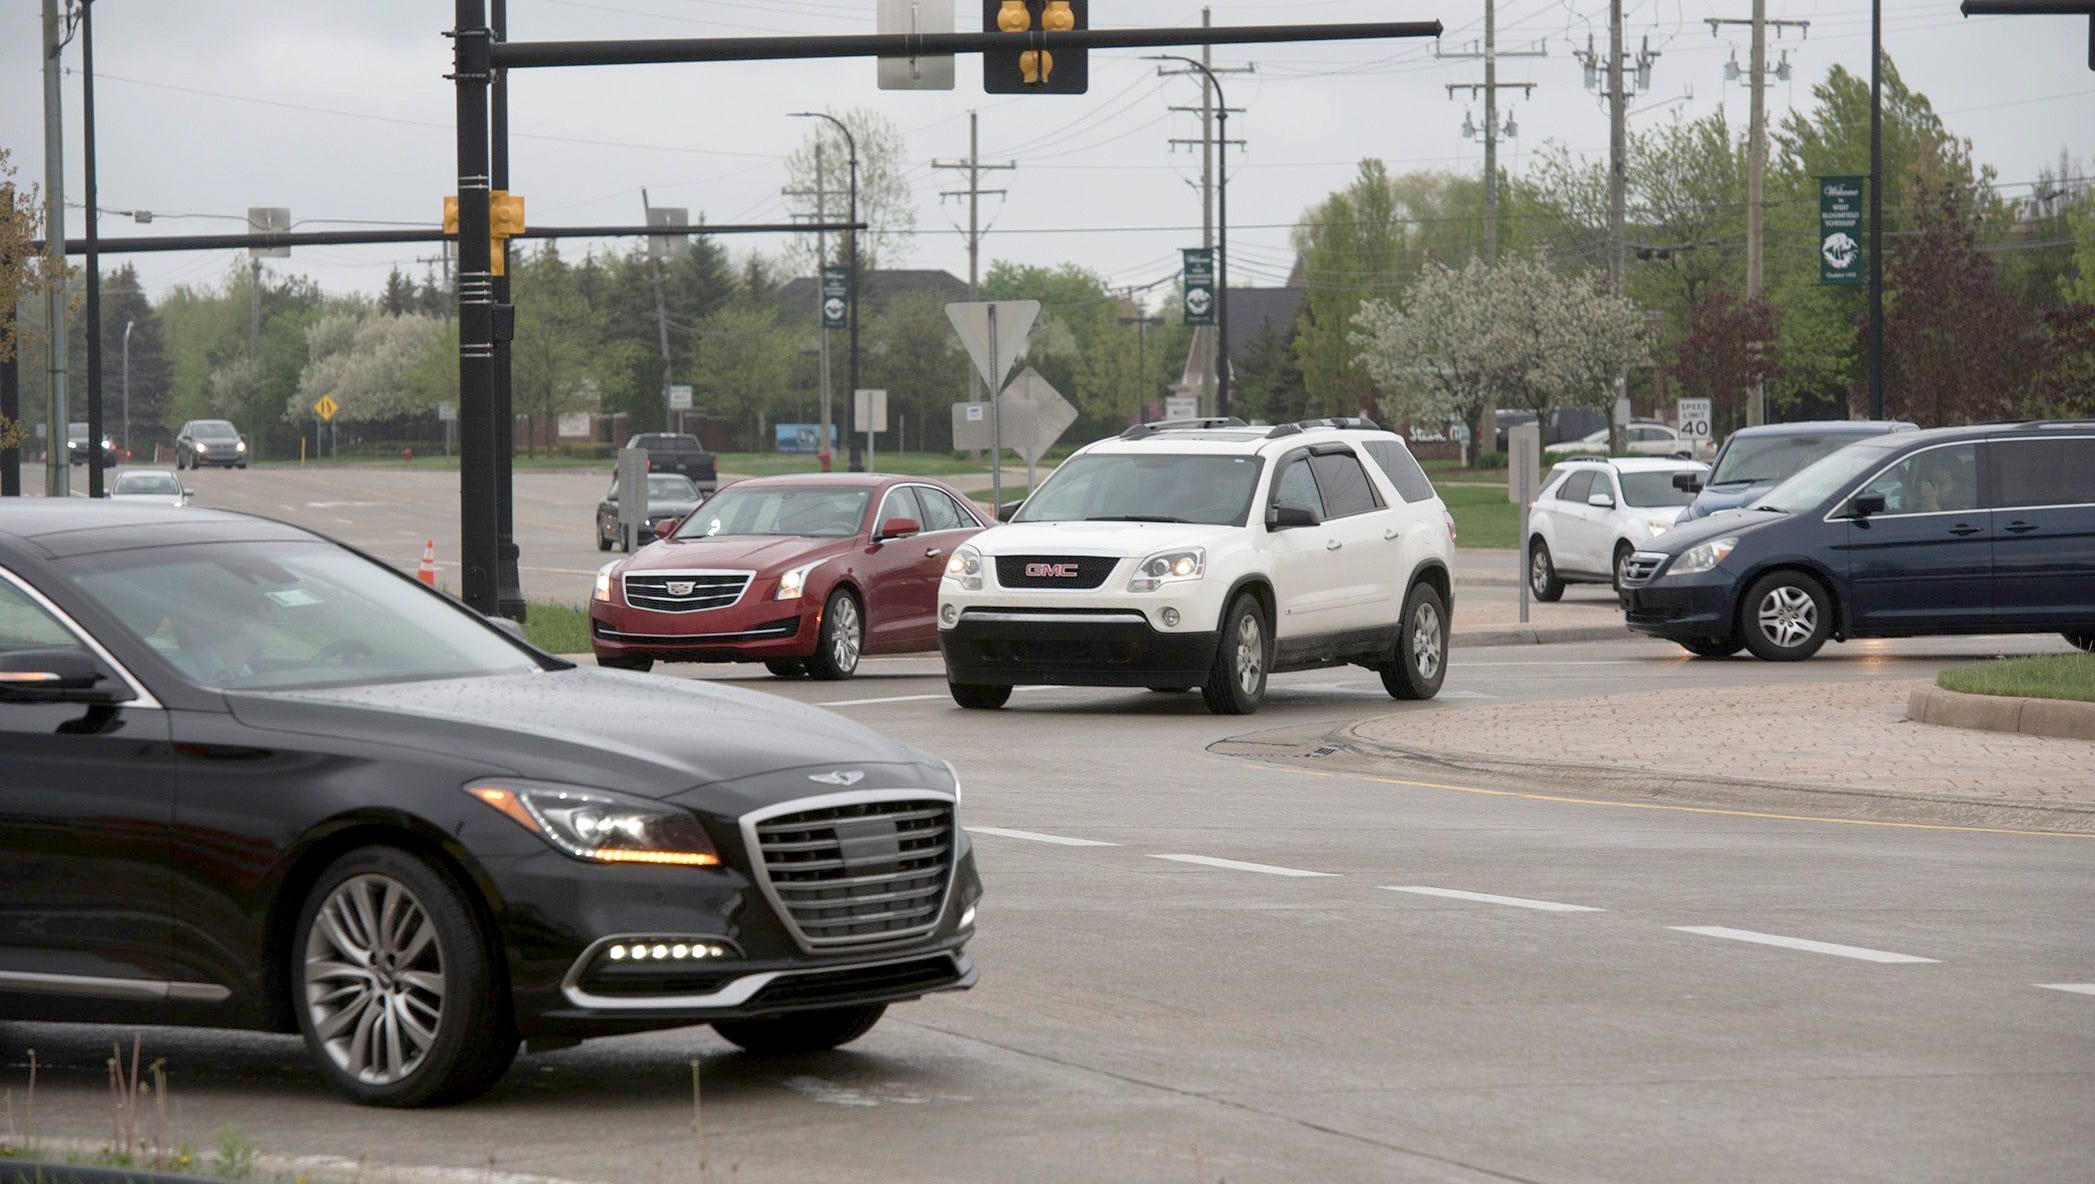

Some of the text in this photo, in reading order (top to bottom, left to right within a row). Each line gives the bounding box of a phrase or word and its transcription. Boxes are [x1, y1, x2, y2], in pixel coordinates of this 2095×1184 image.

[1680, 402, 1709, 410] SPEED
[1682, 411, 1705, 419] LIMIT
[1681, 420, 1708, 436] 40
[1025, 563, 1079, 577] GMC
